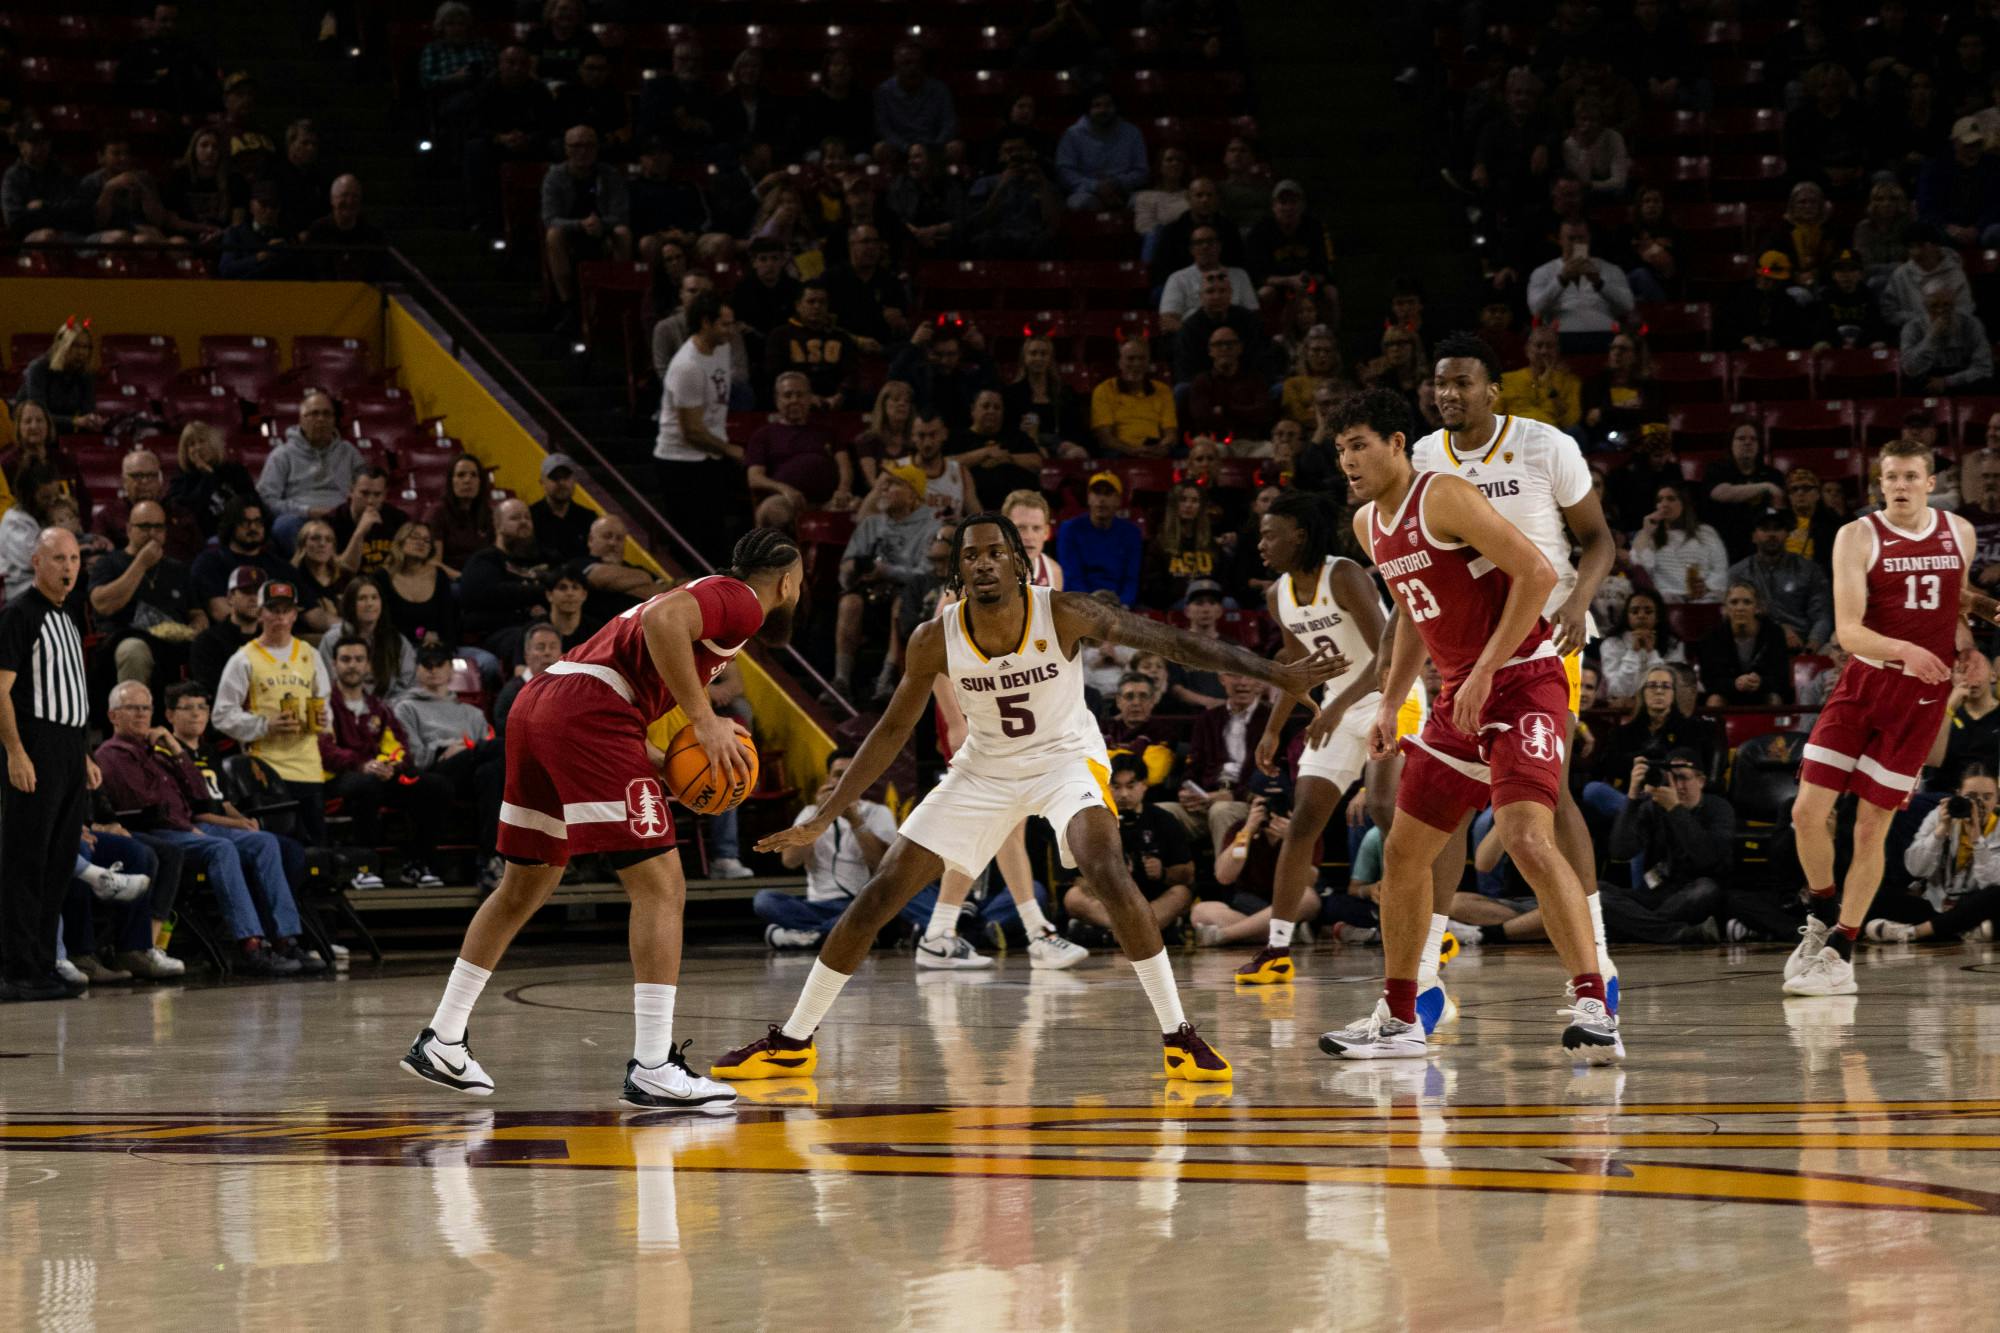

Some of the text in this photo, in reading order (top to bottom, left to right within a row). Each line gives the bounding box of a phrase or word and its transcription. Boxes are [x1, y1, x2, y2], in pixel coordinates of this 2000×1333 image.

[1168, 550, 1214, 576] ASU
[1378, 550, 1433, 580] STANFORD
[1882, 555, 1960, 573] STANFORD
[1397, 578, 1441, 623] 23
[1904, 574, 1941, 610] 13
[1289, 613, 1342, 634] SUN DEVILS
[960, 663, 1059, 692] SUN DEVILS
[996, 693, 1036, 738] 5
[692, 784, 716, 809] NCA
